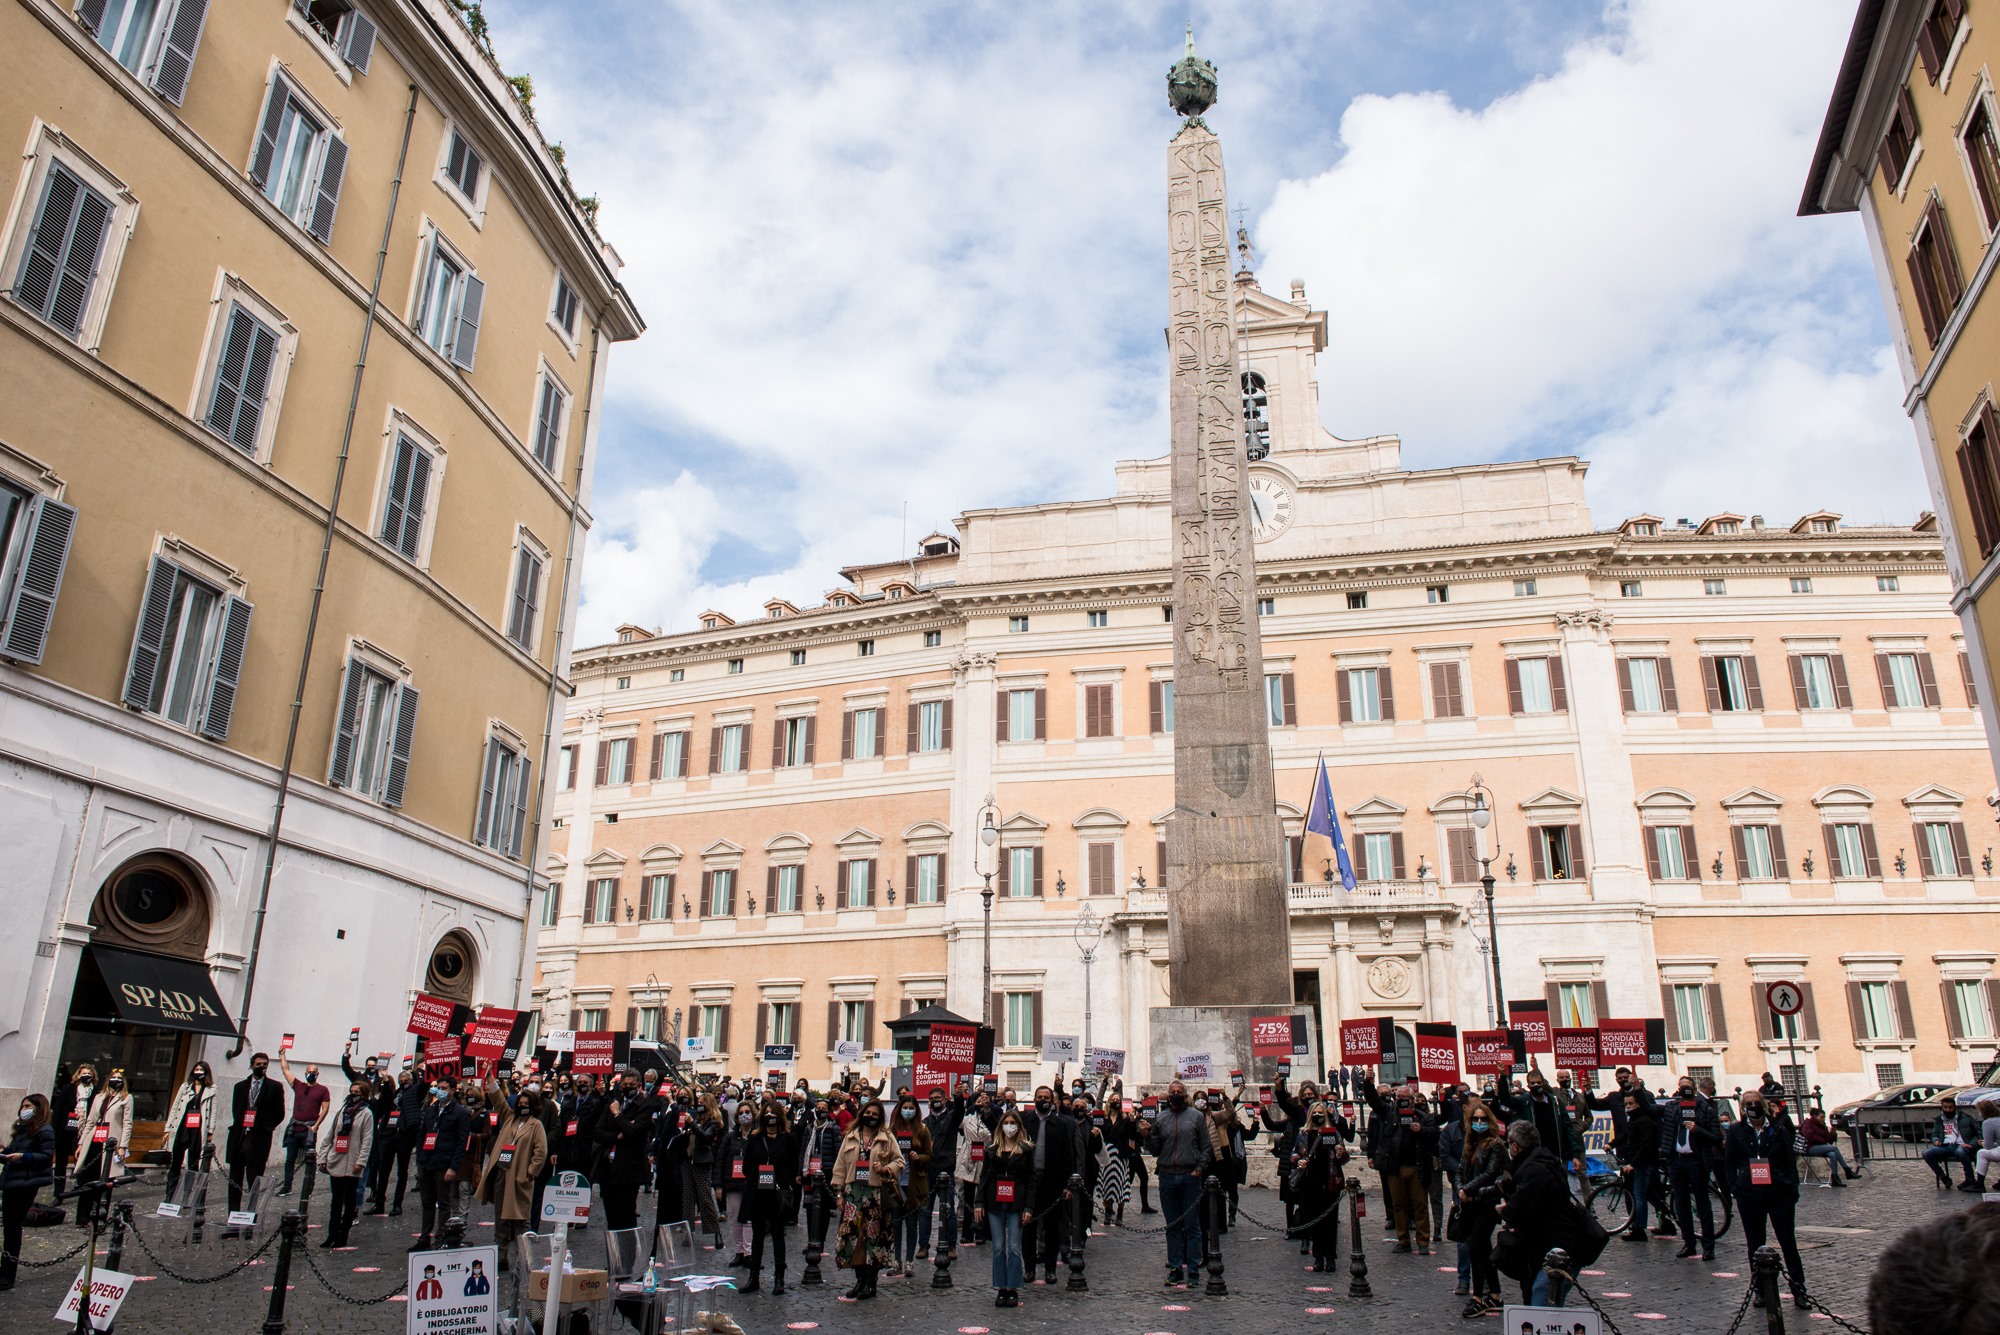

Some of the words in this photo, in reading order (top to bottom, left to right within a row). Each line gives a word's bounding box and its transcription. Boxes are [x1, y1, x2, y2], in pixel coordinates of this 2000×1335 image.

[140, 888, 152, 910] S
[38, 944, 53, 955] 117
[445, 956, 453, 971] S
[121, 983, 219, 1017] SPADA
[418, 1000, 450, 1012] UN'INDUSTRIA
[162, 1010, 193, 1021] ROMA
[430, 1008, 449, 1016] PARLA
[412, 1021, 445, 1033] ASCOLTARE
[427, 1019, 446, 1028] VUOLE
[1254, 1022, 1289, 1035] -75%
[1514, 1022, 1545, 1031] #SOS
[476, 1027, 510, 1035] DIMENTICATO
[479, 1038, 505, 1047] RISTORO
[942, 1036, 974, 1044] ITALIANI
[1346, 1042, 1356, 1050] 36
[1358, 1041, 1378, 1049] MLD
[1466, 1044, 1476, 1052] IL
[945, 1048, 973, 1056] EVENTI
[1421, 1048, 1454, 1059] #SOS
[575, 1058, 612, 1066] SUBITO
[1097, 1059, 1118, 1068] -80%
[426, 1062, 459, 1079] NOI
[1184, 1064, 1206, 1073] -80%
[916, 1072, 946, 1080] congressi
[580, 1279, 600, 1292] Step
[417, 1309, 422, 1319] È
[424, 1305, 488, 1318] OBBLIGATORIO
[428, 1317, 477, 1329] INDOSSARE
